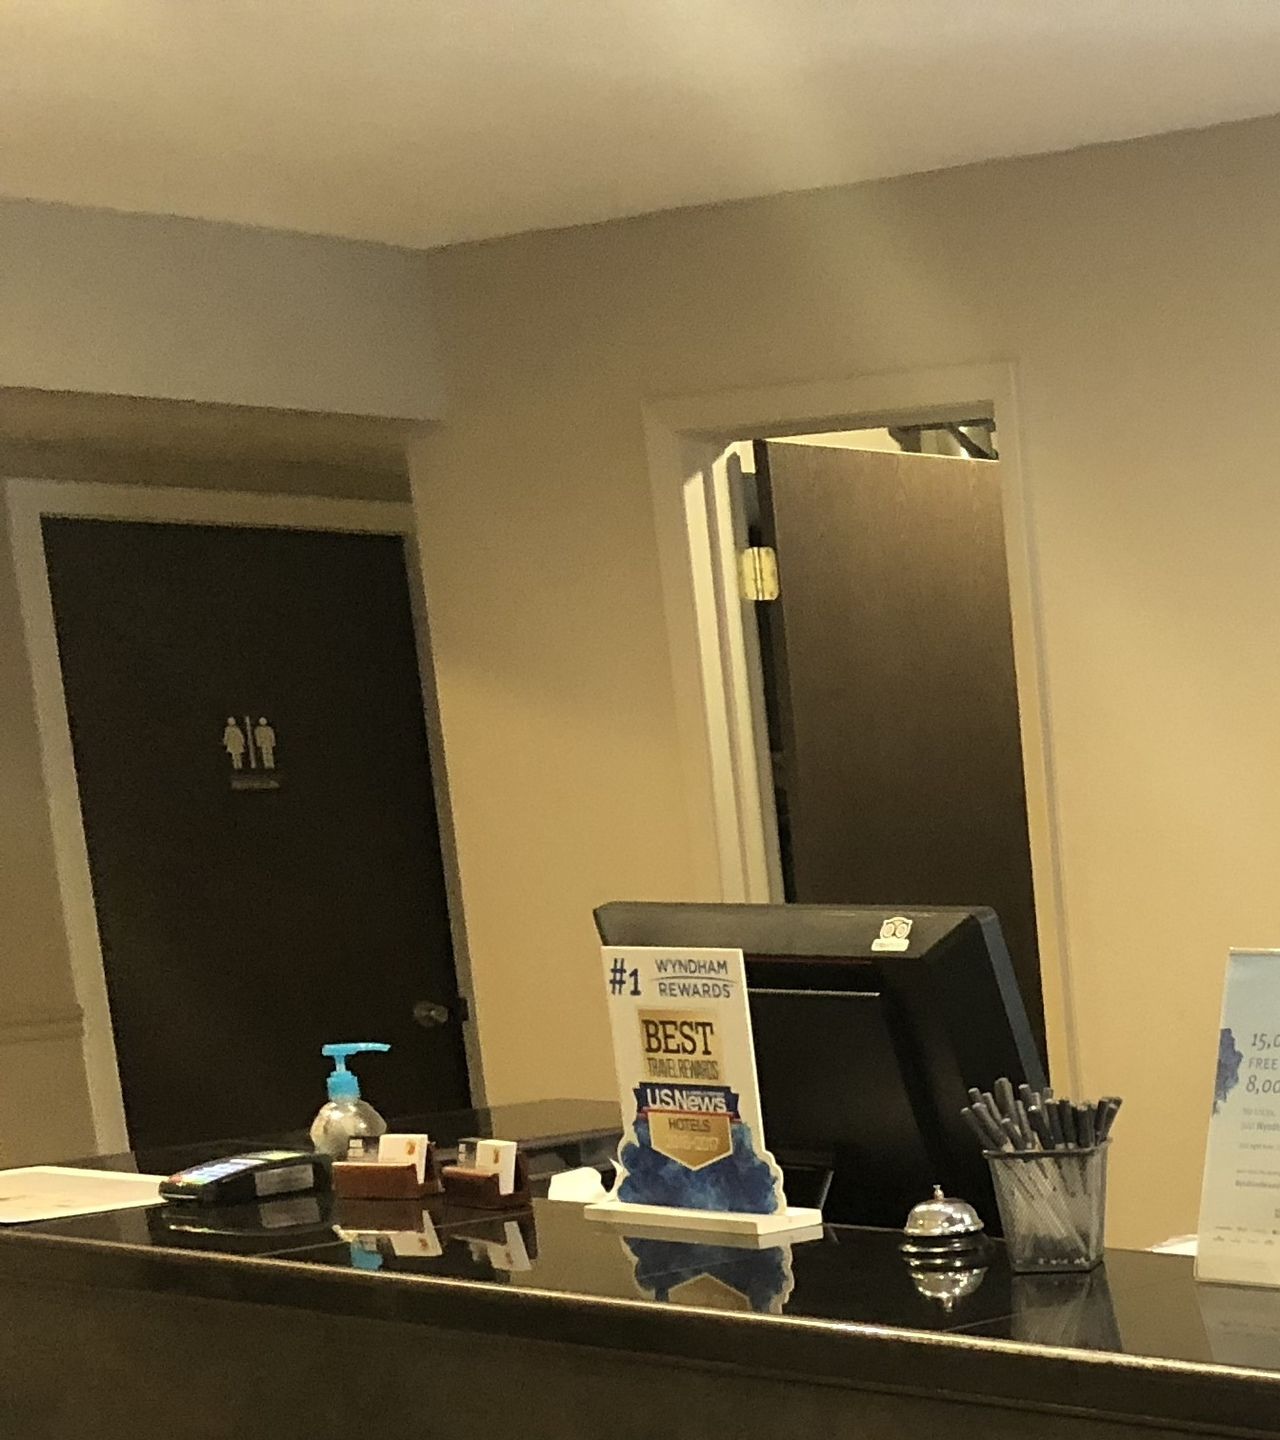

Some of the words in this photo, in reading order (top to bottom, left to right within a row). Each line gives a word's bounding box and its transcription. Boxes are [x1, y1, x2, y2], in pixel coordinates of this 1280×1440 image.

[654, 958, 729, 974] WYNDHAM
[609, 957, 642, 996] #1
[658, 982, 731, 998] REWARDS
[641, 1019, 714, 1055] BEST
[1248, 1057, 1279, 1070] FREE
[668, 1117, 711, 1133] HOTELS
